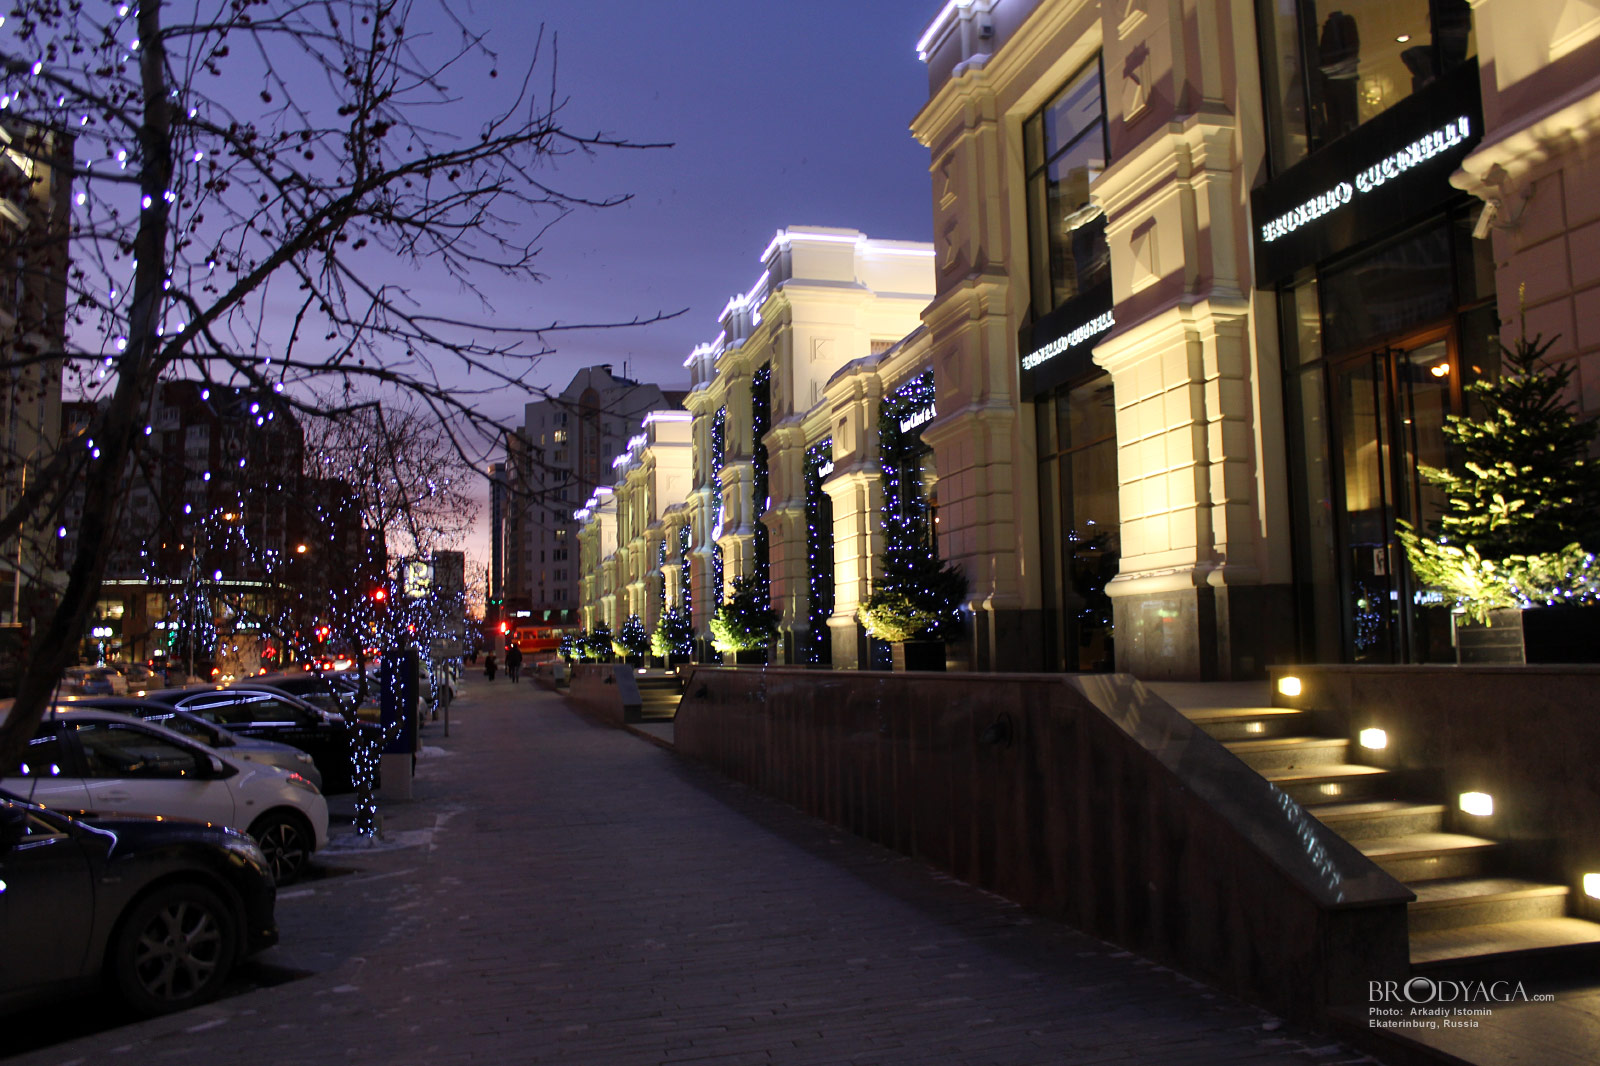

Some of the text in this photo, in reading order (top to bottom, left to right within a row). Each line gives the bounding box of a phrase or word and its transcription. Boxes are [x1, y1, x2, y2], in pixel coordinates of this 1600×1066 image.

[1261, 115, 1470, 242] BRUNELLO CUCINELLI
[1068, 310, 1116, 347] CUCINELL
